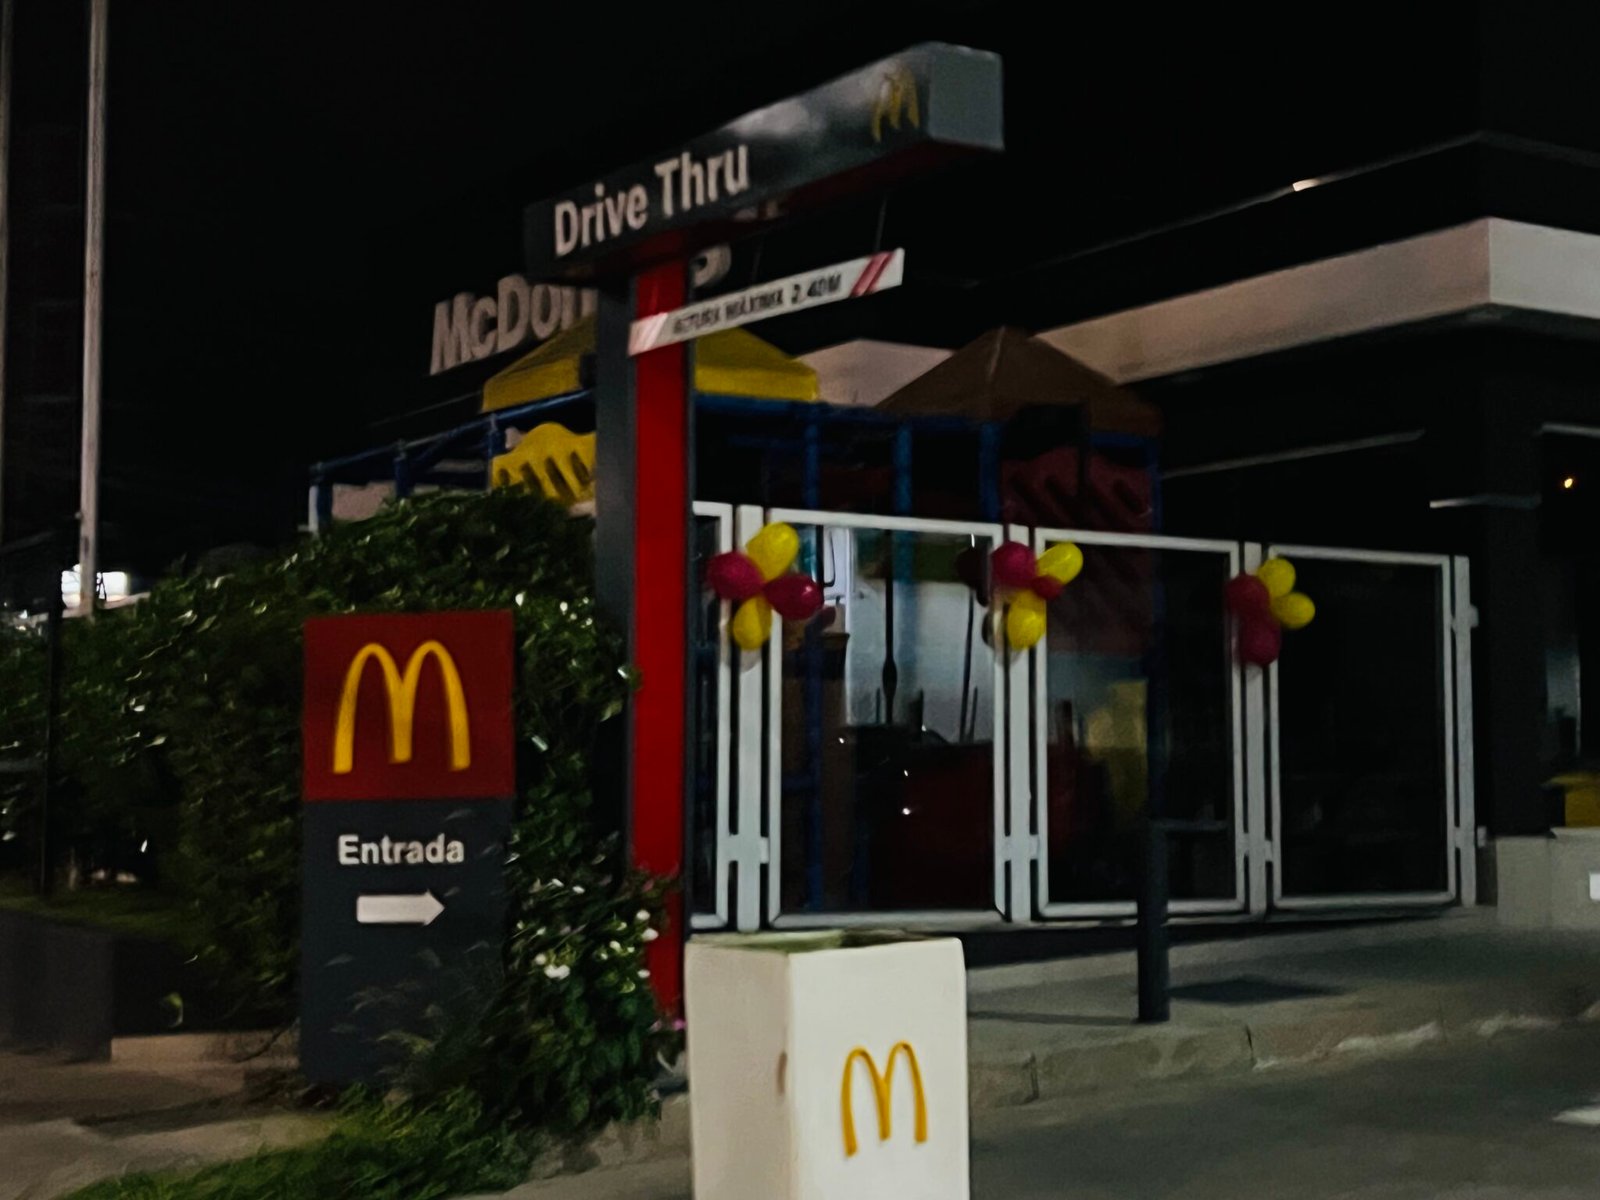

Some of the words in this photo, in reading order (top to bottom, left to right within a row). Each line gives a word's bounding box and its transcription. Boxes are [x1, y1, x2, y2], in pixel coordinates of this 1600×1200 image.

[554, 182, 649, 259] Drive
[653, 144, 750, 220] Thru
[338, 832, 466, 866] Entrada
